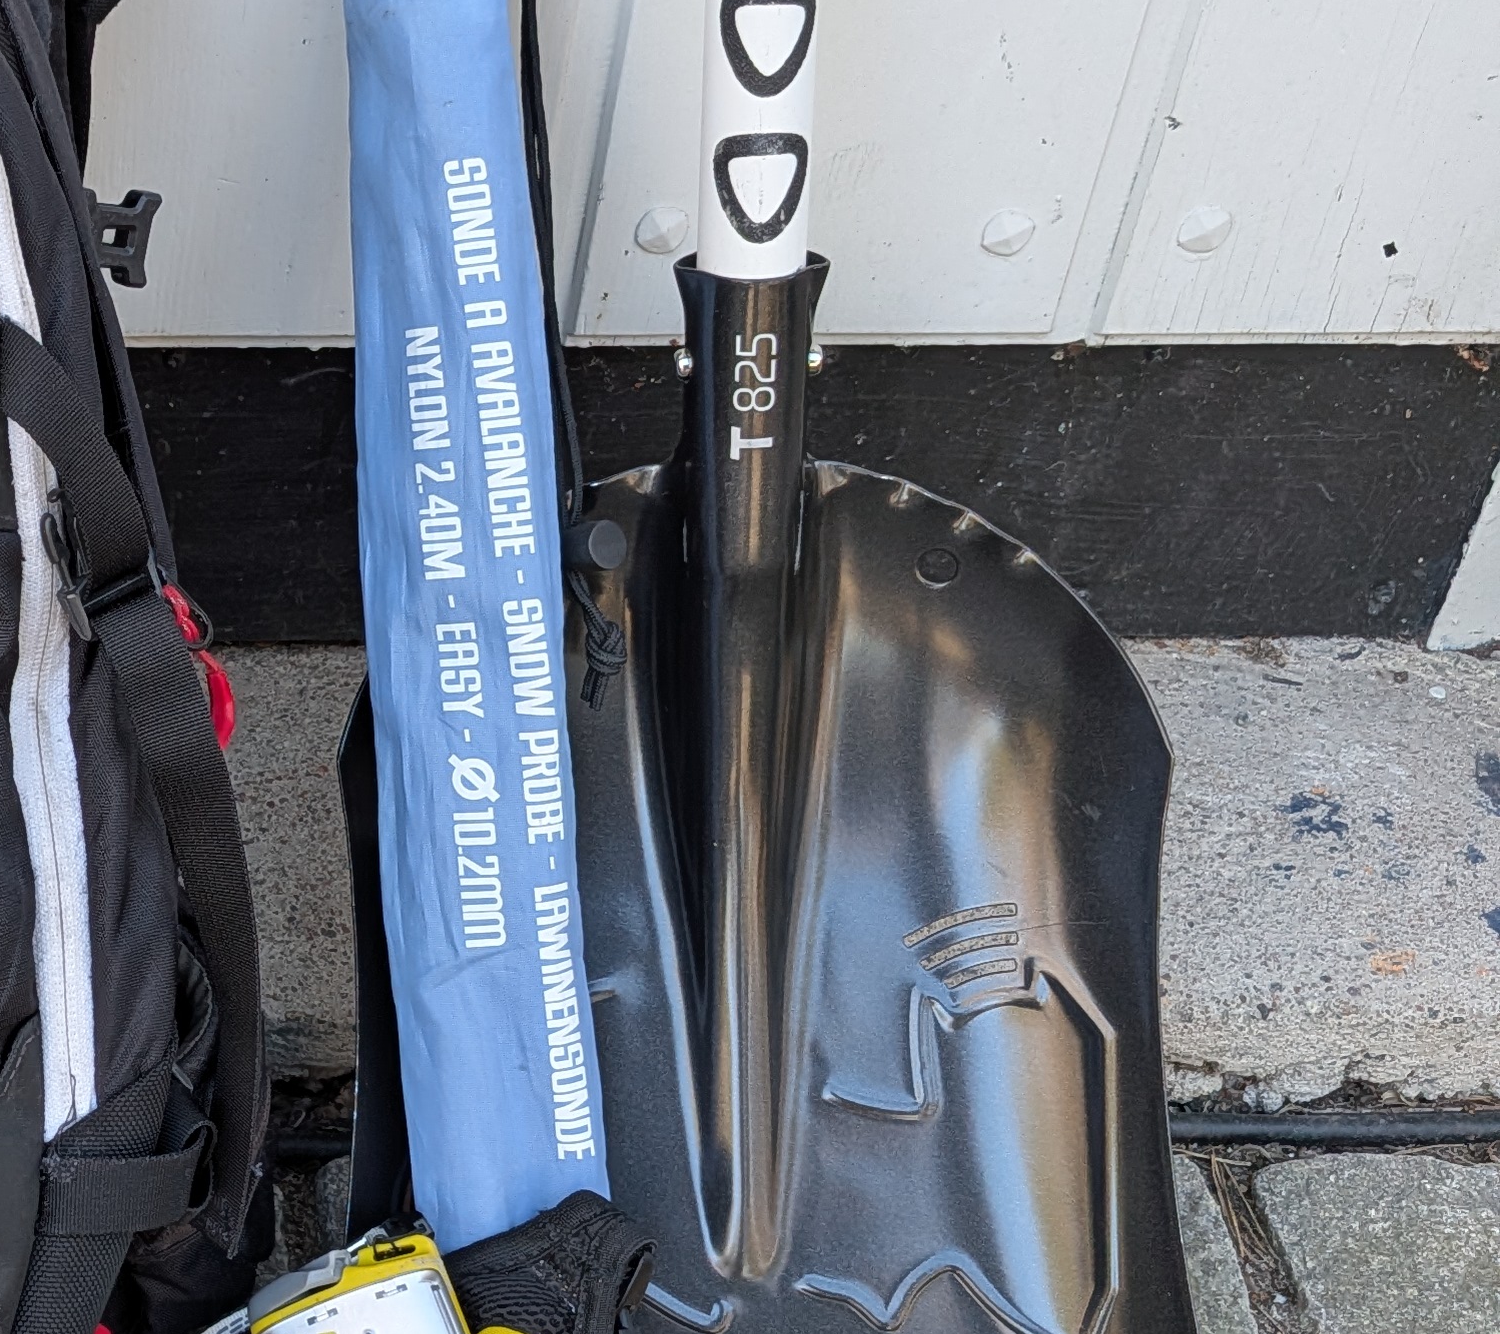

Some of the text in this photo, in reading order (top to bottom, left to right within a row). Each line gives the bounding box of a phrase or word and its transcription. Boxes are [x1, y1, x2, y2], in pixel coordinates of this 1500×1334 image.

[443, 157, 501, 286] SONDE
[464, 299, 508, 329] A
[405, 326, 451, 450] NYLON
[471, 340, 536, 558] AVALANCHE
[729, 333, 777, 461] T 825
[414, 461, 466, 581] 2.40M
[435, 621, 485, 718] EASY
[502, 598, 556, 716] SNOW
[518, 729, 565, 845] PROBE
[533, 881, 596, 1161] LAWINENSONDE
